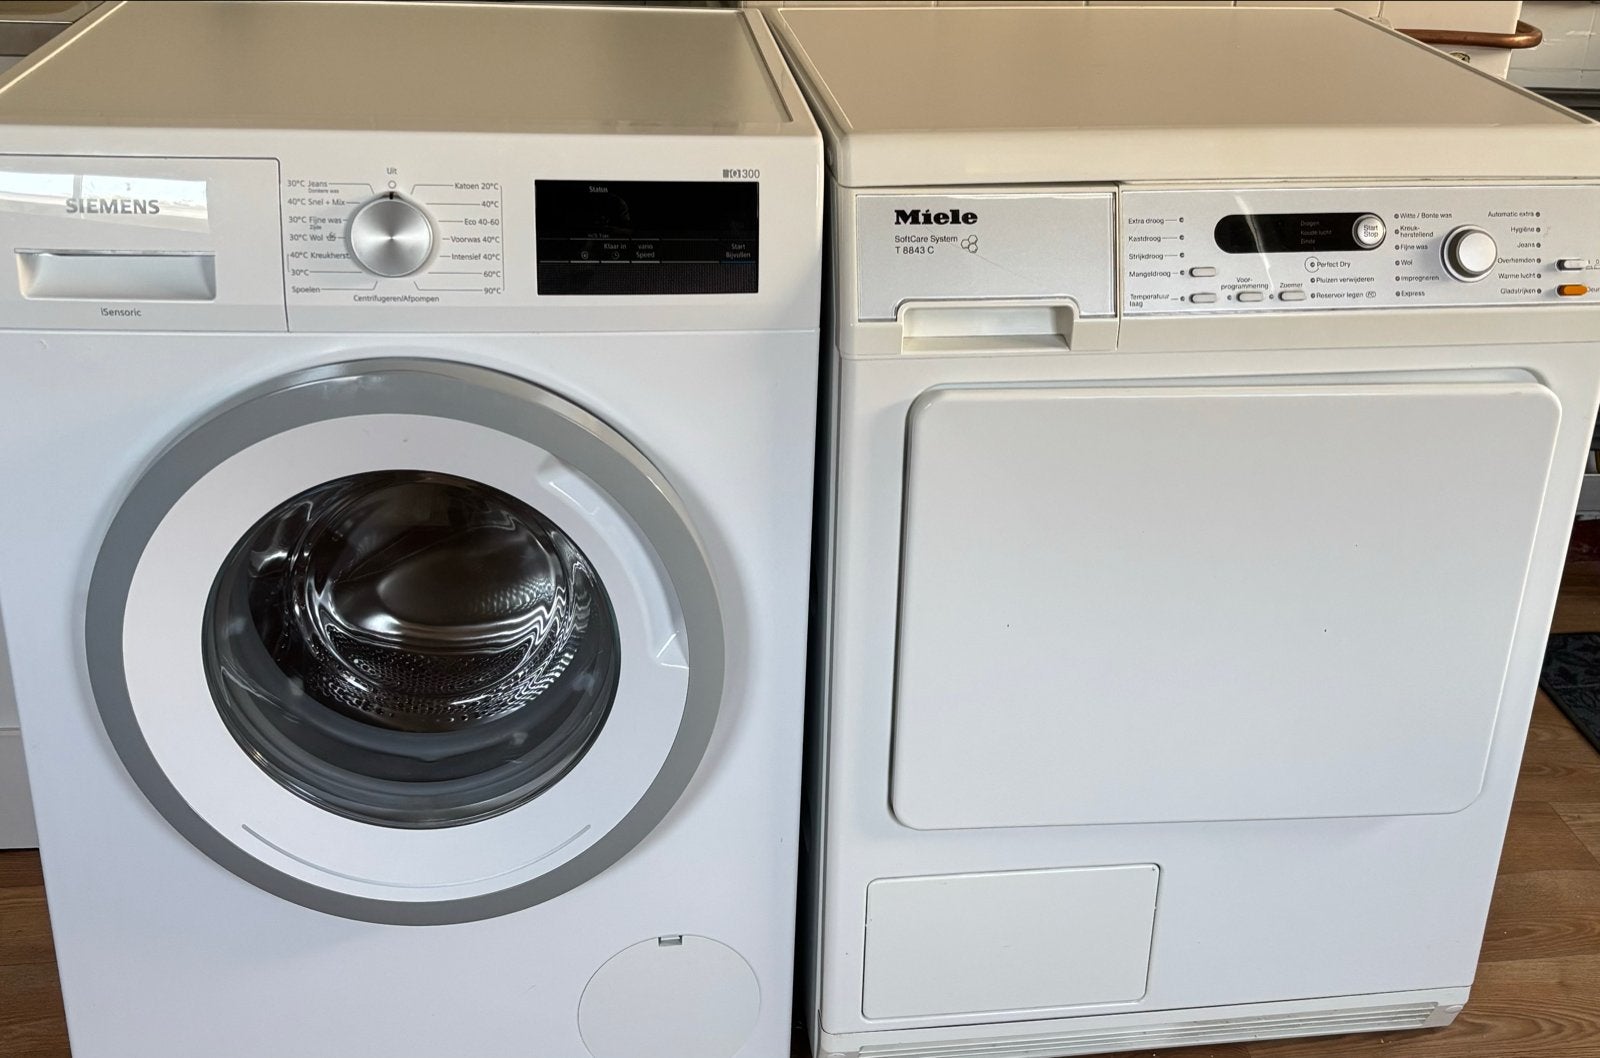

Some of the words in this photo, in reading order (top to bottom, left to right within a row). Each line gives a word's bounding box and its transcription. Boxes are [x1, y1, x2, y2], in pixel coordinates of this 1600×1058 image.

[387, 167, 397, 175] Uit
[455, 182, 479, 190] Katoen
[481, 182, 499, 190] 20°C
[589, 185, 608, 193] Status
[308, 198, 324, 206] Snel
[481, 200, 499, 208] 40°C
[65, 198, 160, 215] SIEMENS
[309, 216, 326, 225] Fijne
[894, 209, 978, 225] Miele
[1145, 217, 1165, 225] droog
[464, 218, 477, 226] Eco
[478, 218, 500, 226] 40-60
[290, 233, 308, 241] 30°C
[894, 235, 928, 243] SoftCare
[930, 235, 958, 244] System
[895, 246, 901, 254] T
[902, 246, 925, 255] 8843
[927, 246, 935, 254] C
[290, 251, 308, 259] 40°C
[482, 253, 500, 261] 40°C
[636, 251, 655, 260] Speed
[1128, 253, 1164, 261] Strijkdroog
[483, 270, 501, 278] 60°C
[291, 286, 320, 294] Spoelen
[1220, 283, 1269, 291] programmering
[353, 294, 440, 303] Centrifugeren/Afpompen
[101, 307, 142, 317] iSensoric
